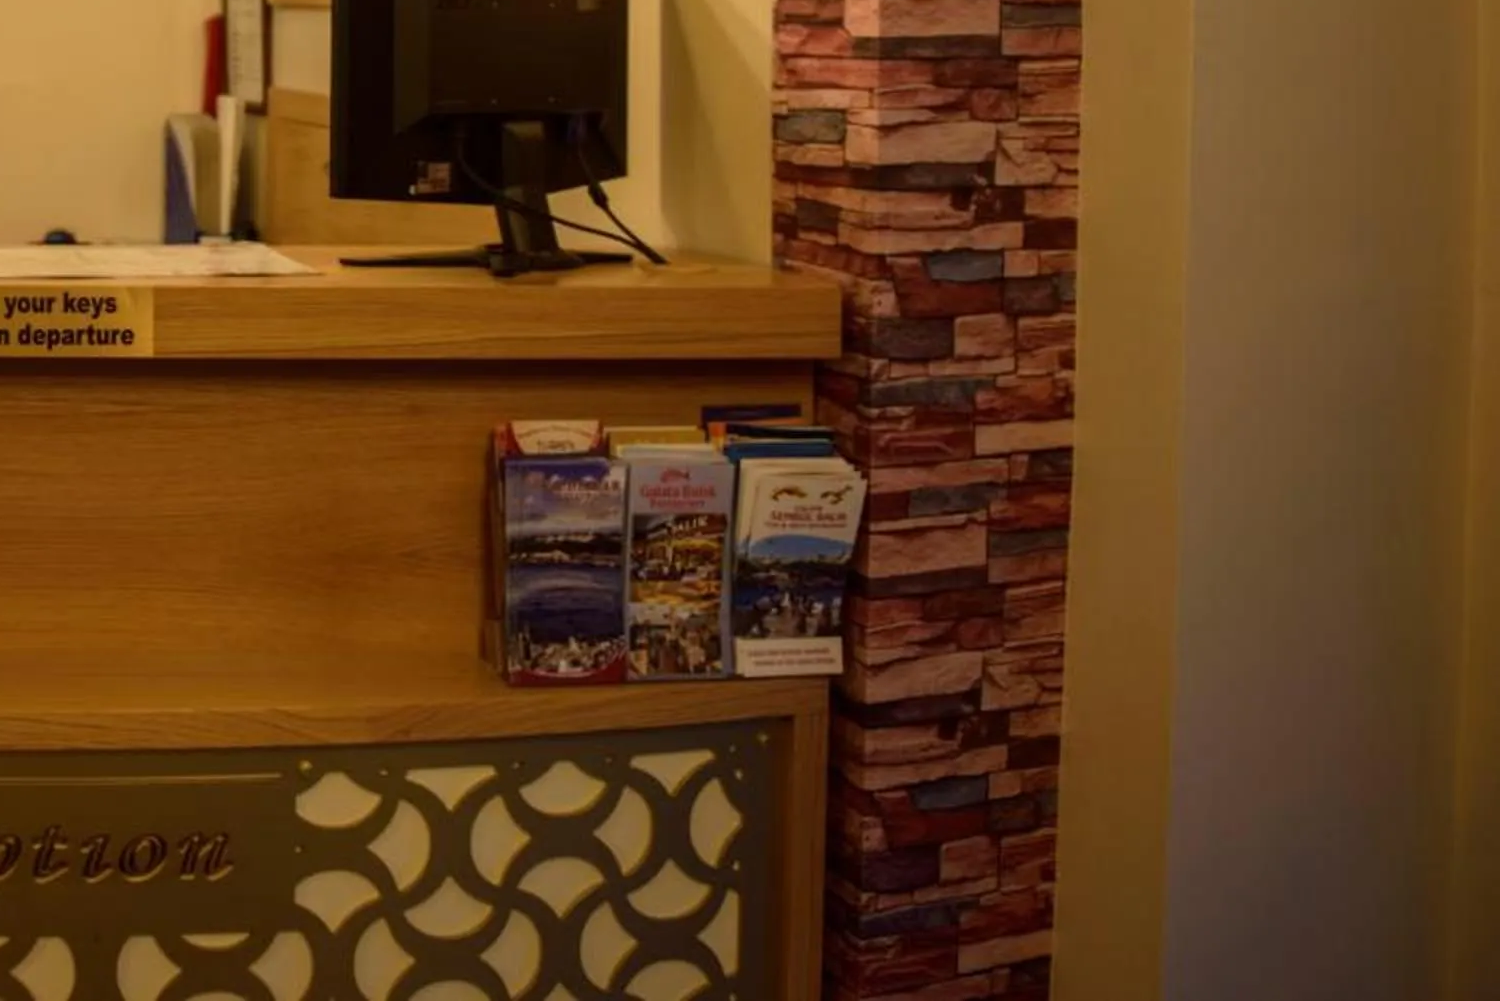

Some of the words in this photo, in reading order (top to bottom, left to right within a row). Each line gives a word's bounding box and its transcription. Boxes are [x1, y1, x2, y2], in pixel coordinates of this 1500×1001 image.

[4, 295, 54, 319] your
[63, 292, 118, 319] keys
[18, 324, 136, 349] departure
